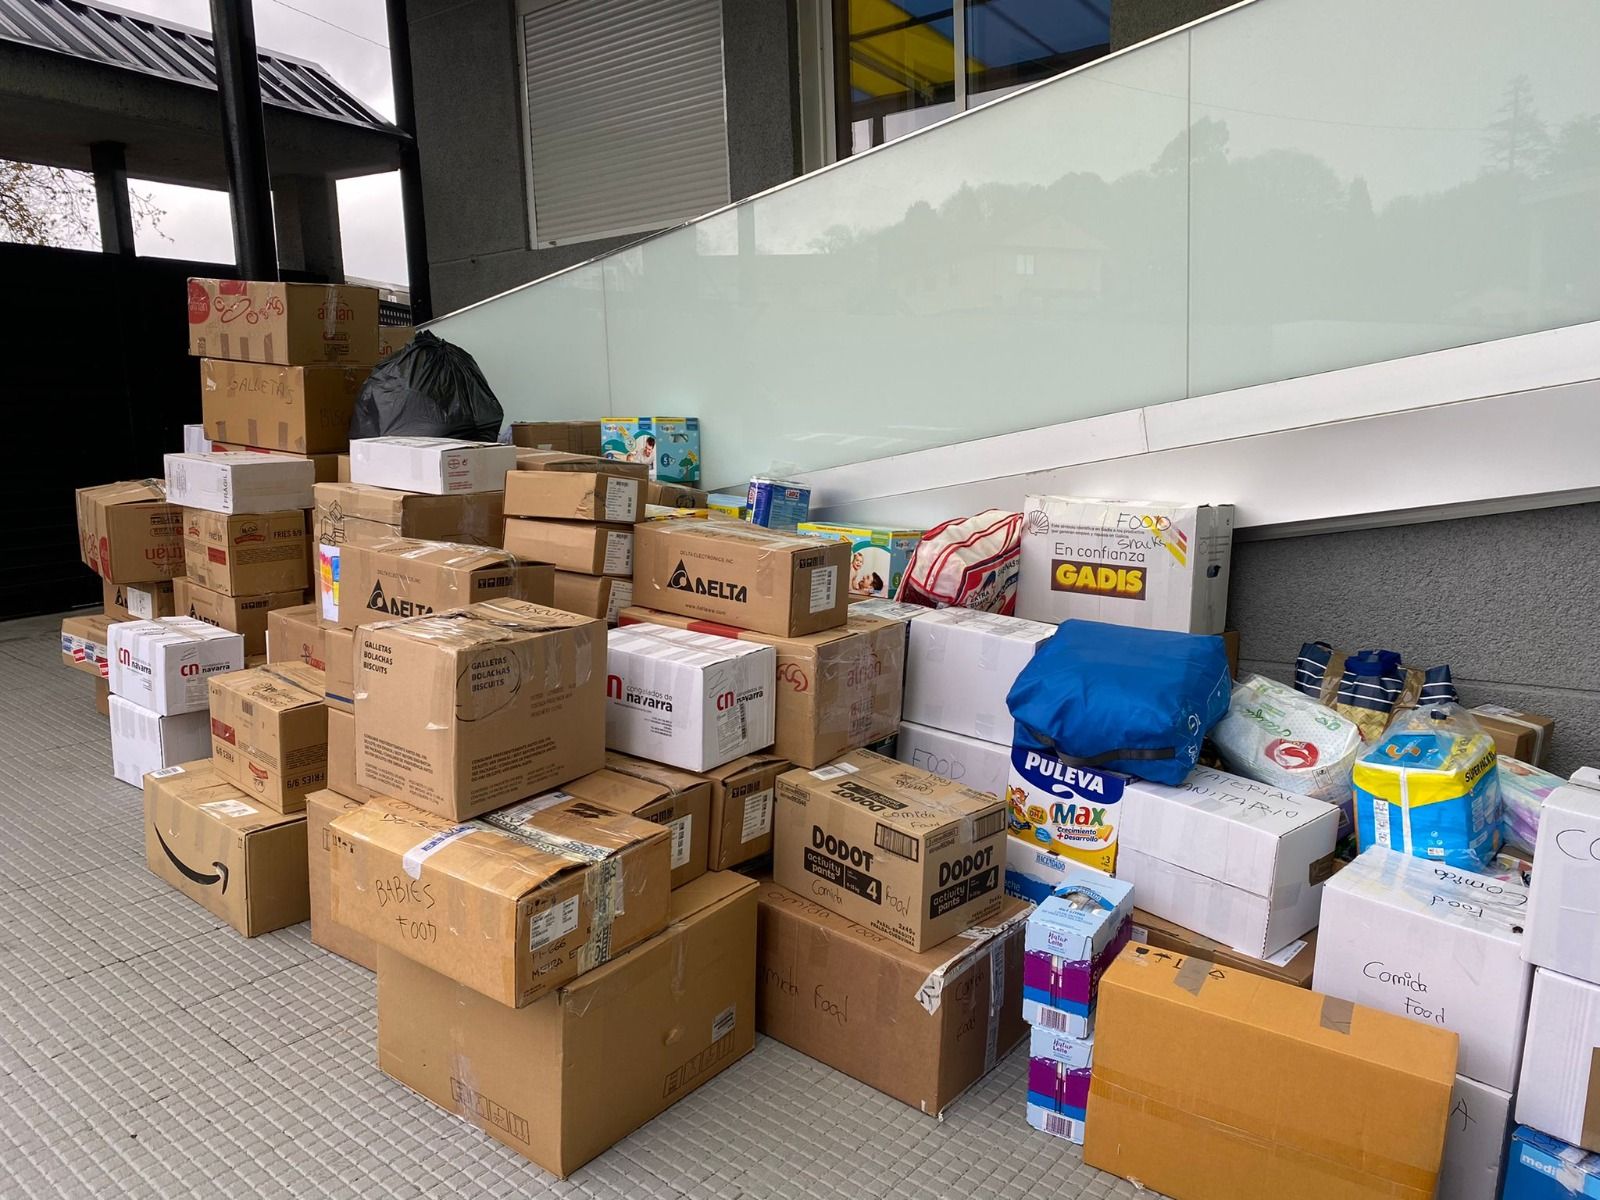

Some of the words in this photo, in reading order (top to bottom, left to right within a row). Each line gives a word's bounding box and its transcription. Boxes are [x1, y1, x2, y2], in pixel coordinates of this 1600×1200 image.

[1055, 542, 1073, 557] En
[1077, 544, 1145, 563] confianza
[1055, 563, 1144, 594] GADIS
[695, 577, 748, 604] DELTA
[364, 640, 392, 655] GALLETAS
[131, 661, 152, 676] navarra
[202, 664, 231, 674] navarra
[363, 651, 393, 666] BOLACHAS
[363, 661, 388, 675] BISCUITS
[471, 656, 508, 670] GALLETAS
[471, 666, 511, 681] BOLACHAS
[471, 679, 505, 692] BISCUITS
[626, 694, 673, 713] navarra
[736, 689, 764, 704] navarra
[911, 748, 966, 780] FOOD
[1024, 751, 1105, 795] PULEVA
[302, 773, 325, 785] FRIES
[831, 789, 887, 812] DODOT
[1178, 783, 1299, 818] ANITARIO
[1052, 802, 1107, 827] Max
[1057, 826, 1097, 836] Crecimiento
[812, 825, 874, 872] DODOT
[807, 852, 842, 878] activity
[812, 864, 837, 881] pants
[938, 845, 994, 887] DODOT
[1036, 852, 1066, 872] HACENDADO
[985, 870, 995, 888] 4
[375, 876, 435, 909] BABIES
[811, 879, 843, 905] Comida
[866, 880, 878, 900] 4
[886, 884, 911, 917] Food
[933, 884, 966, 905] activity
[938, 896, 961, 915] pants
[1362, 960, 1429, 994] Comida
[813, 984, 849, 1026] Food
[1403, 997, 1446, 1025] Food
[1521, 1153, 1557, 1177] medi
